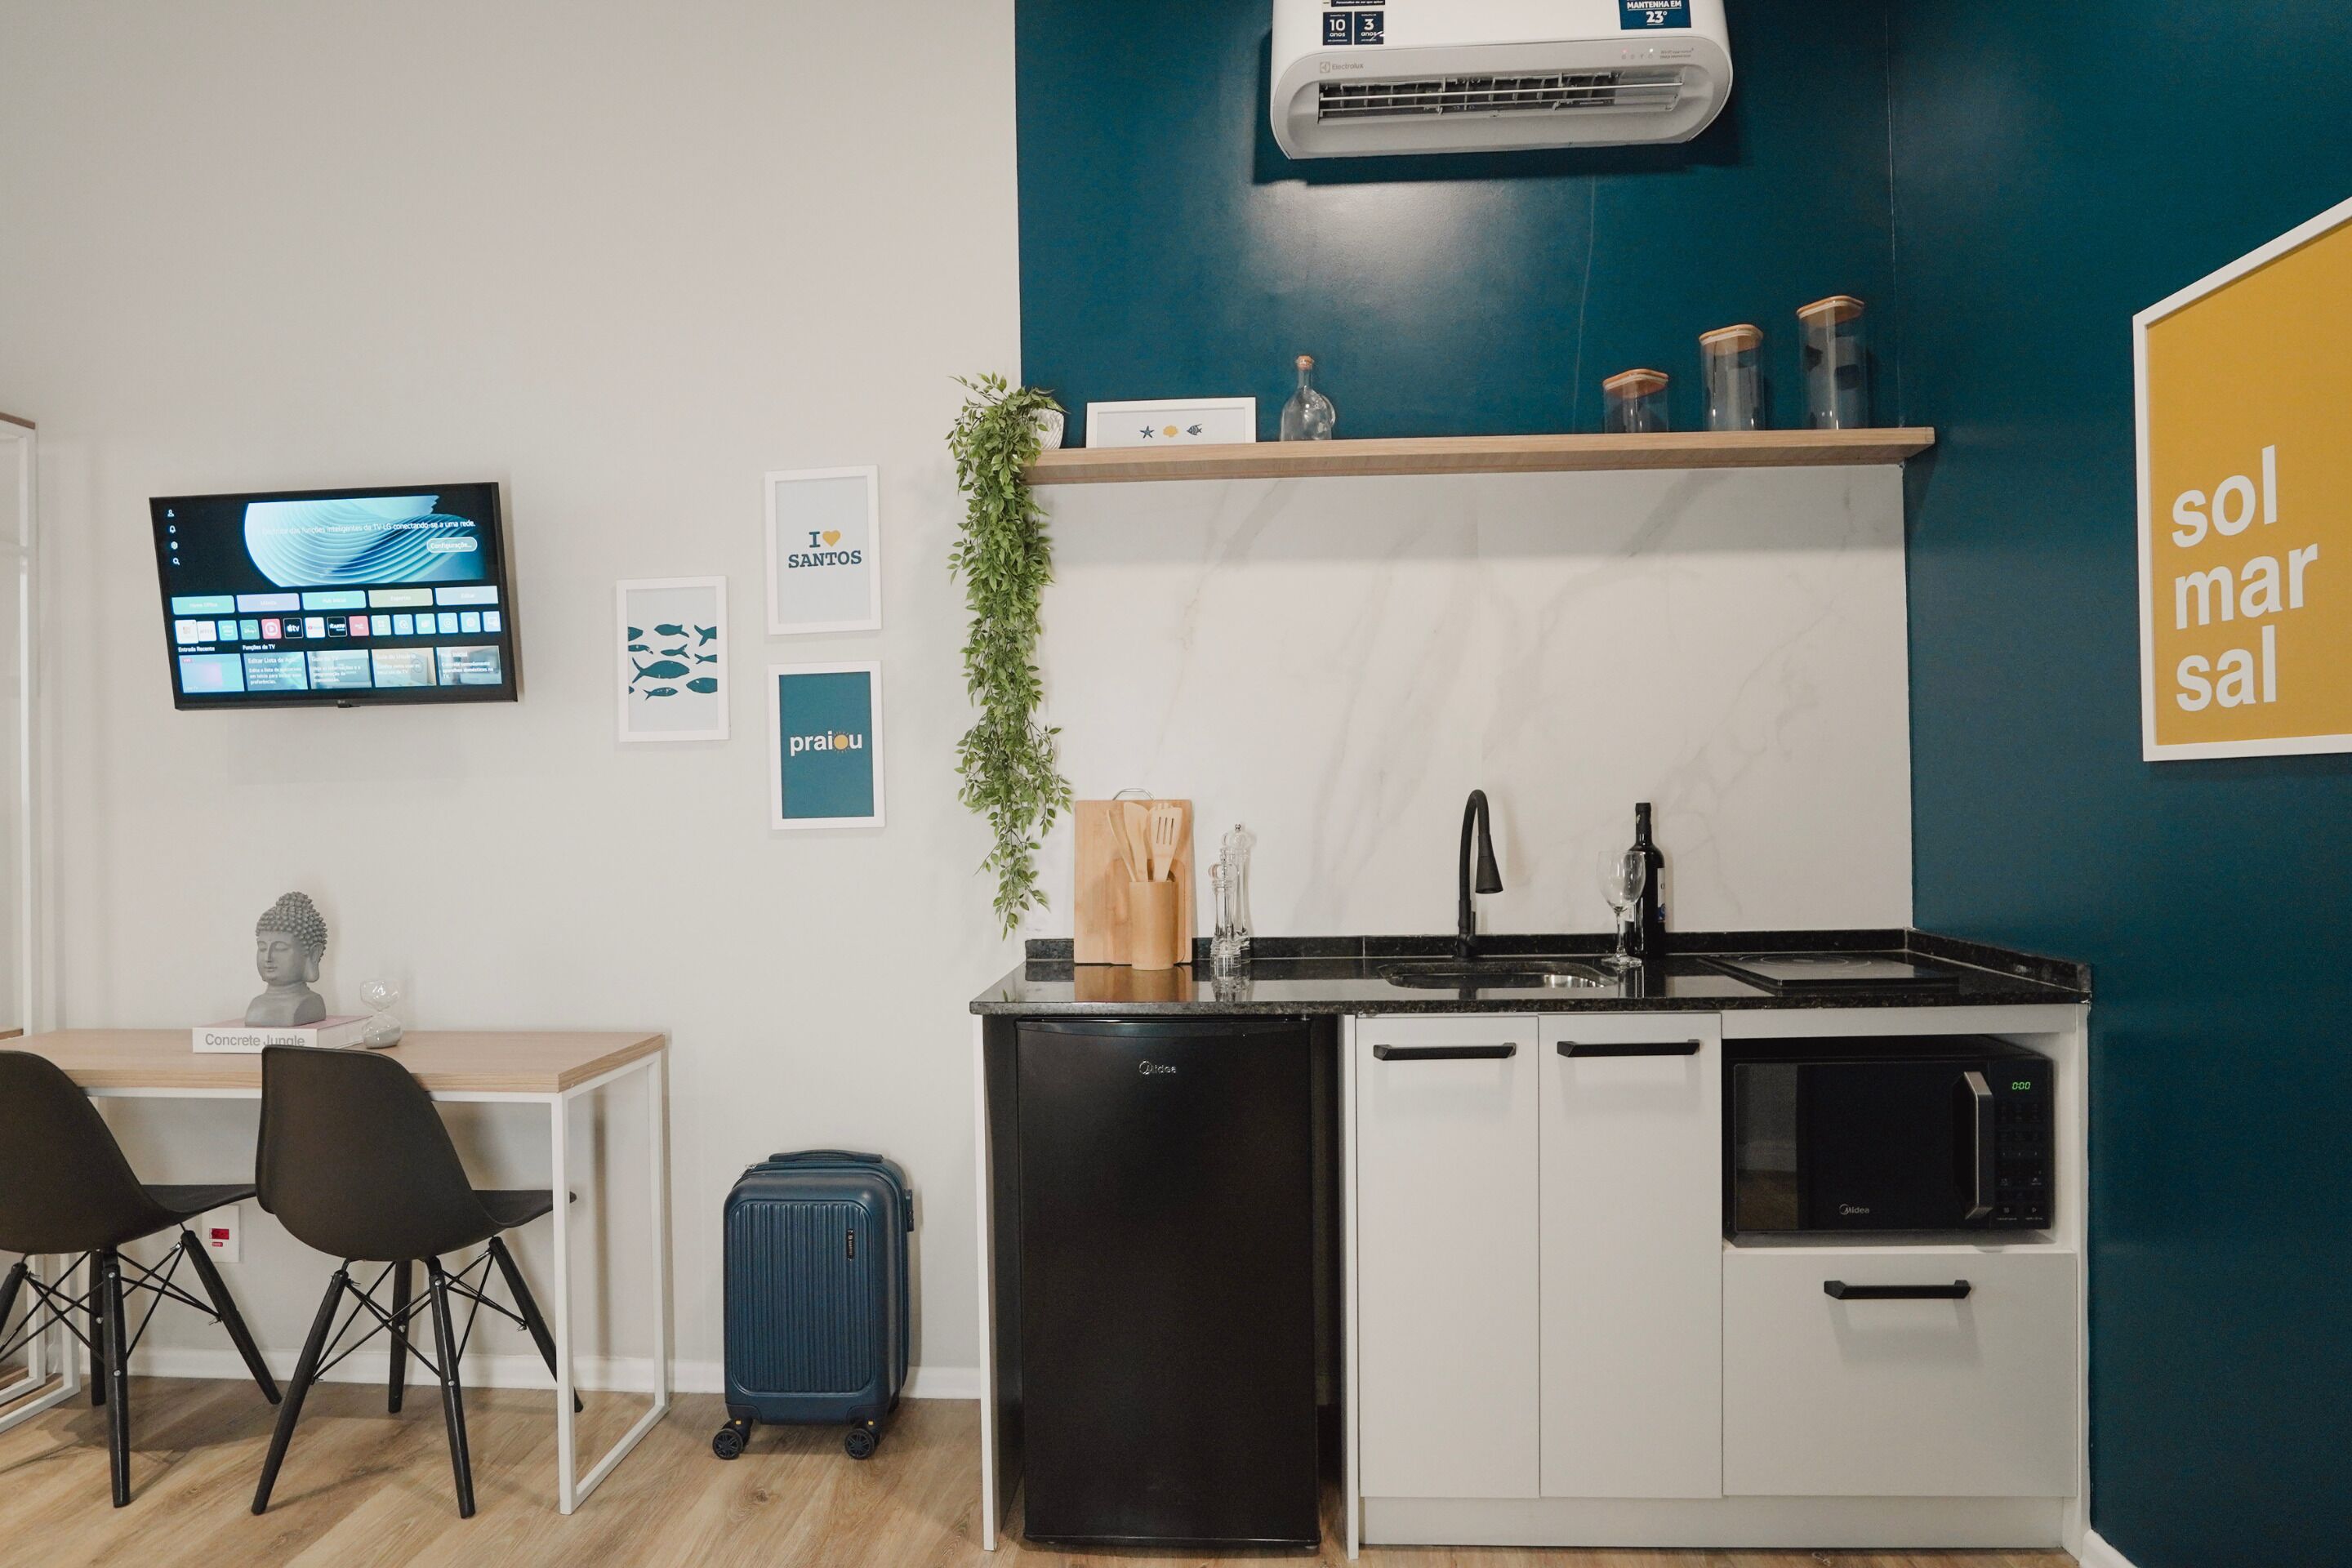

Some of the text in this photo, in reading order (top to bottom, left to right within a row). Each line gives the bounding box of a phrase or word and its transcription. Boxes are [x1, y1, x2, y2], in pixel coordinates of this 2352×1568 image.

[1627, 1, 1669, 9] MANTENHA
[1646, 11, 1668, 24] 23°
[1330, 19, 1346, 31] 10
[1364, 19, 1374, 30] 3
[1332, 62, 1364, 70] Electrolux
[2172, 444, 2277, 548] sol
[393, 521, 439, 530] conectando-se
[808, 531, 821, 548] I
[788, 550, 862, 568] SANTOS
[2175, 543, 2318, 630] mar
[2176, 625, 2277, 712] sal
[790, 731, 862, 756] praiou
[205, 1034, 261, 1046] Concrete
[2011, 1081, 2031, 1091] 0:00
[1839, 1203, 1870, 1215] Midea
